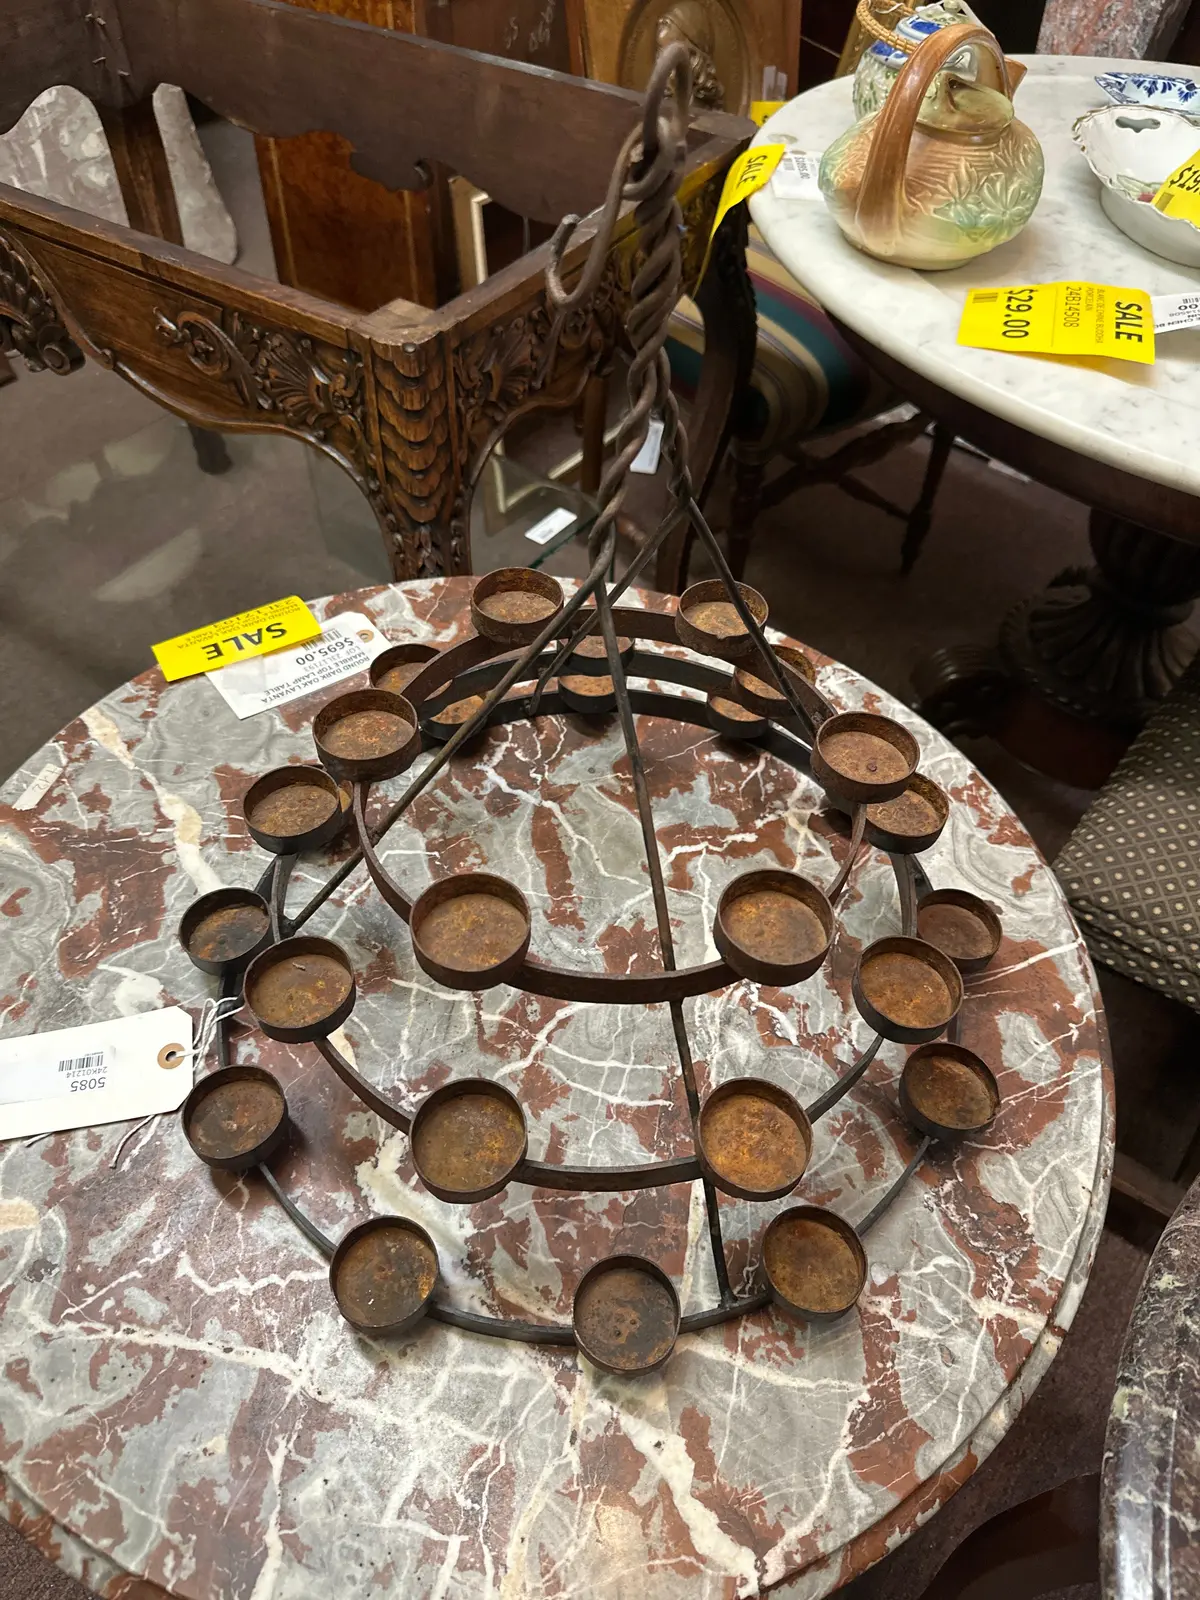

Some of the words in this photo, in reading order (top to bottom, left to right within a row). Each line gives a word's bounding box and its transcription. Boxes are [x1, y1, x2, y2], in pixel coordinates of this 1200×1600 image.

[736, 155, 768, 190] SALE
[1168, 164, 1200, 195] $19.
[1001, 288, 1038, 339] $29.00
[1063, 286, 1082, 328] 24B14508
[1115, 301, 1143, 343] SALE
[264, 603, 299, 617] MARBLE
[268, 607, 301, 621] ROUND
[242, 617, 264, 628] DARK
[244, 614, 260, 623] TOP
[216, 621, 243, 633] LAMP
[222, 625, 241, 636] OAK
[177, 631, 221, 649] LAVANTA
[185, 630, 213, 643] TABLE
[201, 622, 287, 660] SALE
[295, 637, 354, 665] $695.00
[335, 651, 366, 667] MARBLE
[343, 656, 370, 671] ROUND
[316, 663, 334, 675] TOP
[321, 668, 343, 680] DARK
[292, 670, 316, 685] LAMP
[302, 677, 320, 688] OAK
[260, 683, 302, 703] LAVANTA
[264, 681, 292, 696] TABLE
[66, 1066, 108, 1078] 24K01214
[70, 1076, 106, 1092] 5085
